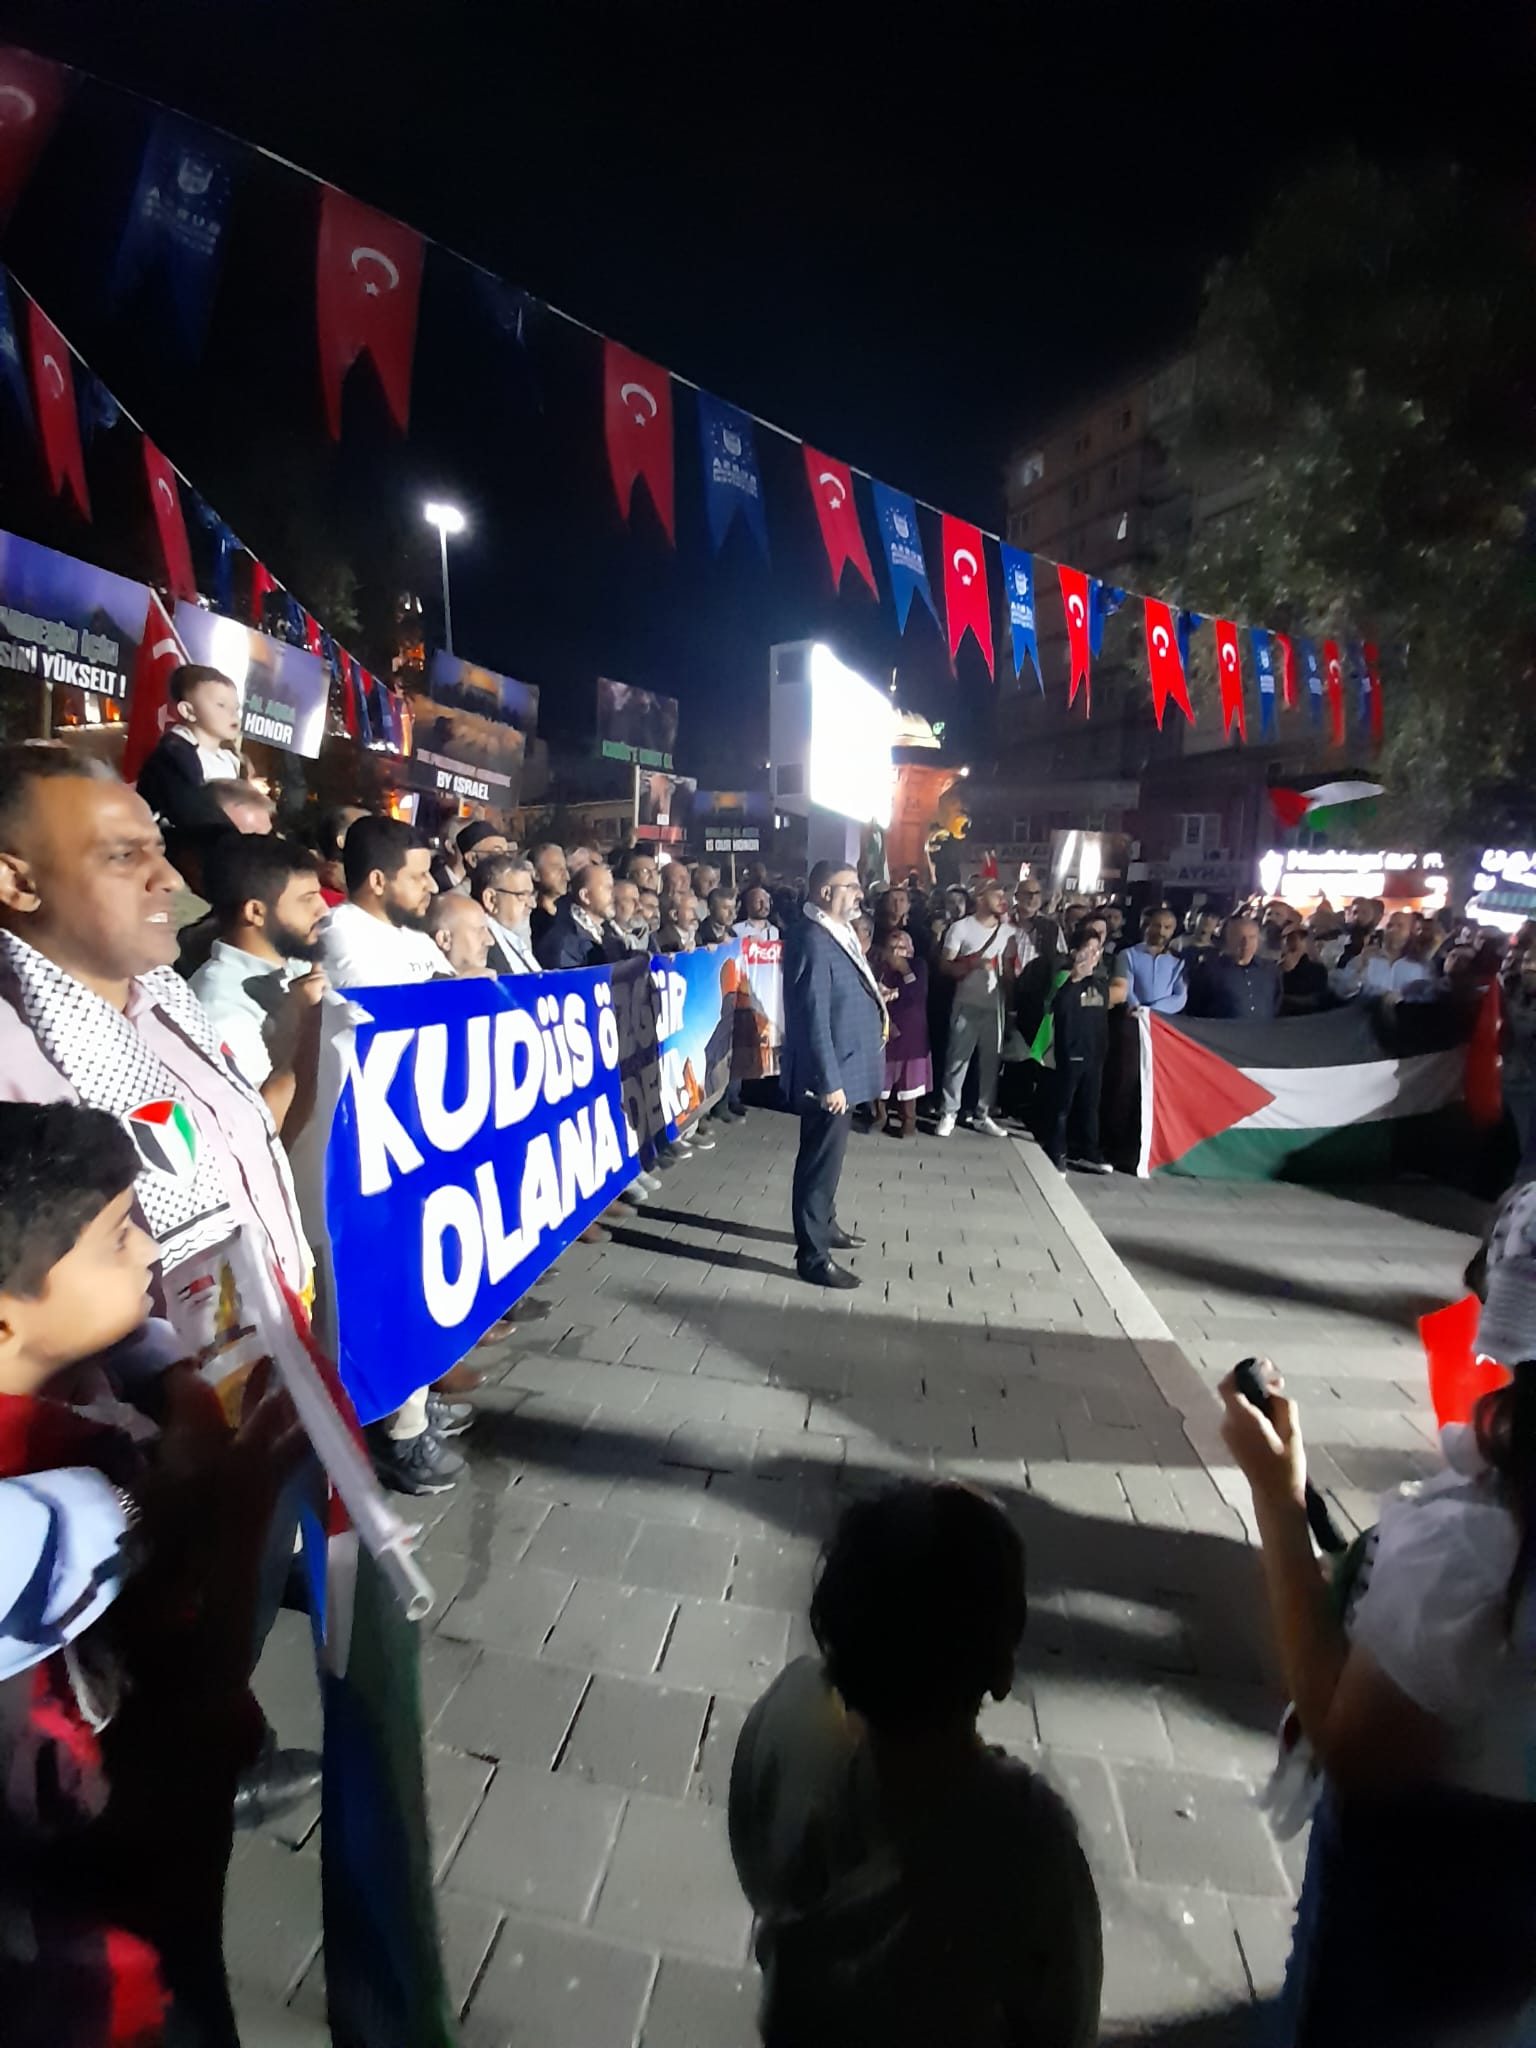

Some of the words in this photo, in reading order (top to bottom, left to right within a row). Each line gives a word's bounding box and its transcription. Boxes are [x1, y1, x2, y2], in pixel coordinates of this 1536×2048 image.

[42, 652, 117, 696] YÜKSELT
[244, 712, 293, 745] HONOR
[436, 770, 453, 790] BY
[453, 776, 490, 801] ISRAEL
[350, 993, 594, 1196] KUDÜS
[422, 1093, 623, 1328] OLANA
